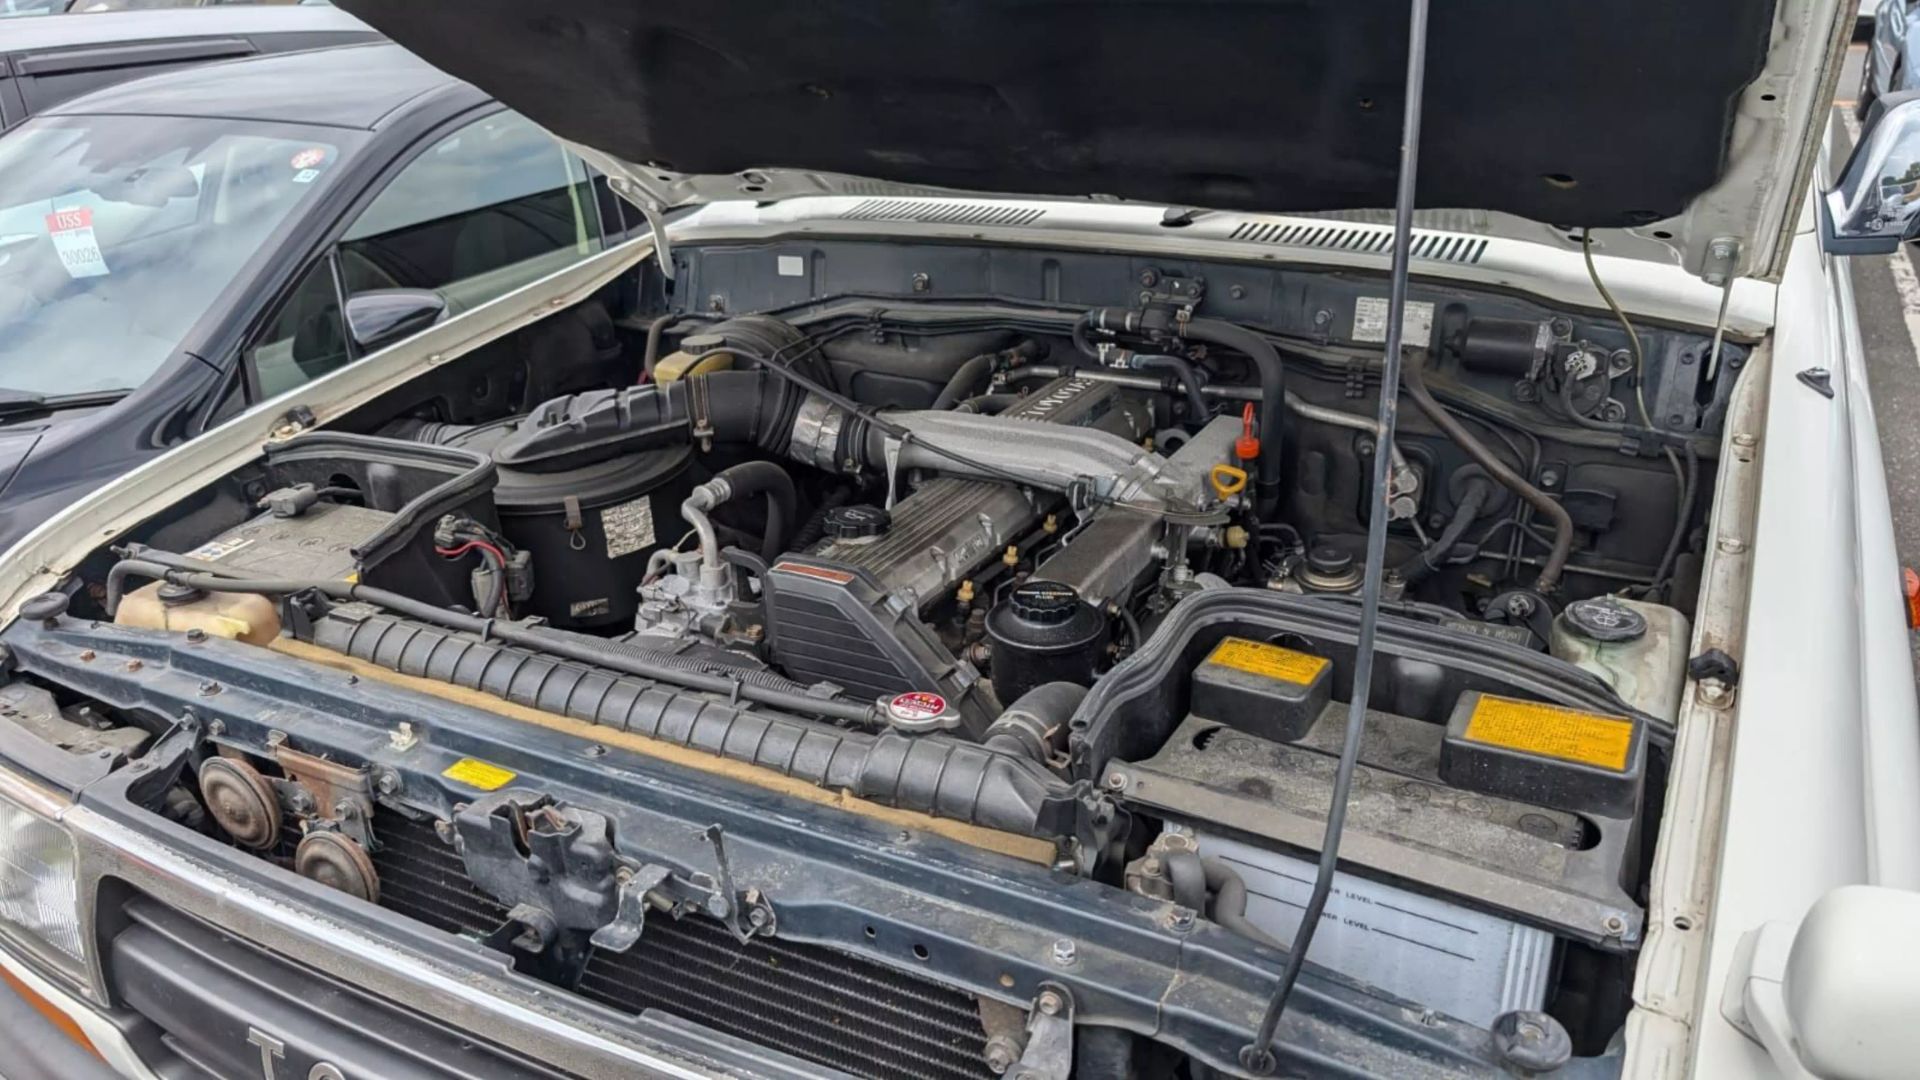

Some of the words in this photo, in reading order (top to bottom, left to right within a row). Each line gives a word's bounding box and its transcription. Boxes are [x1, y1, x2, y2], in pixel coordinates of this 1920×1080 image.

[57, 212, 81, 229] USS
[1346, 892, 1372, 904] LEVEL
[1344, 918, 1370, 930] LEVEL
